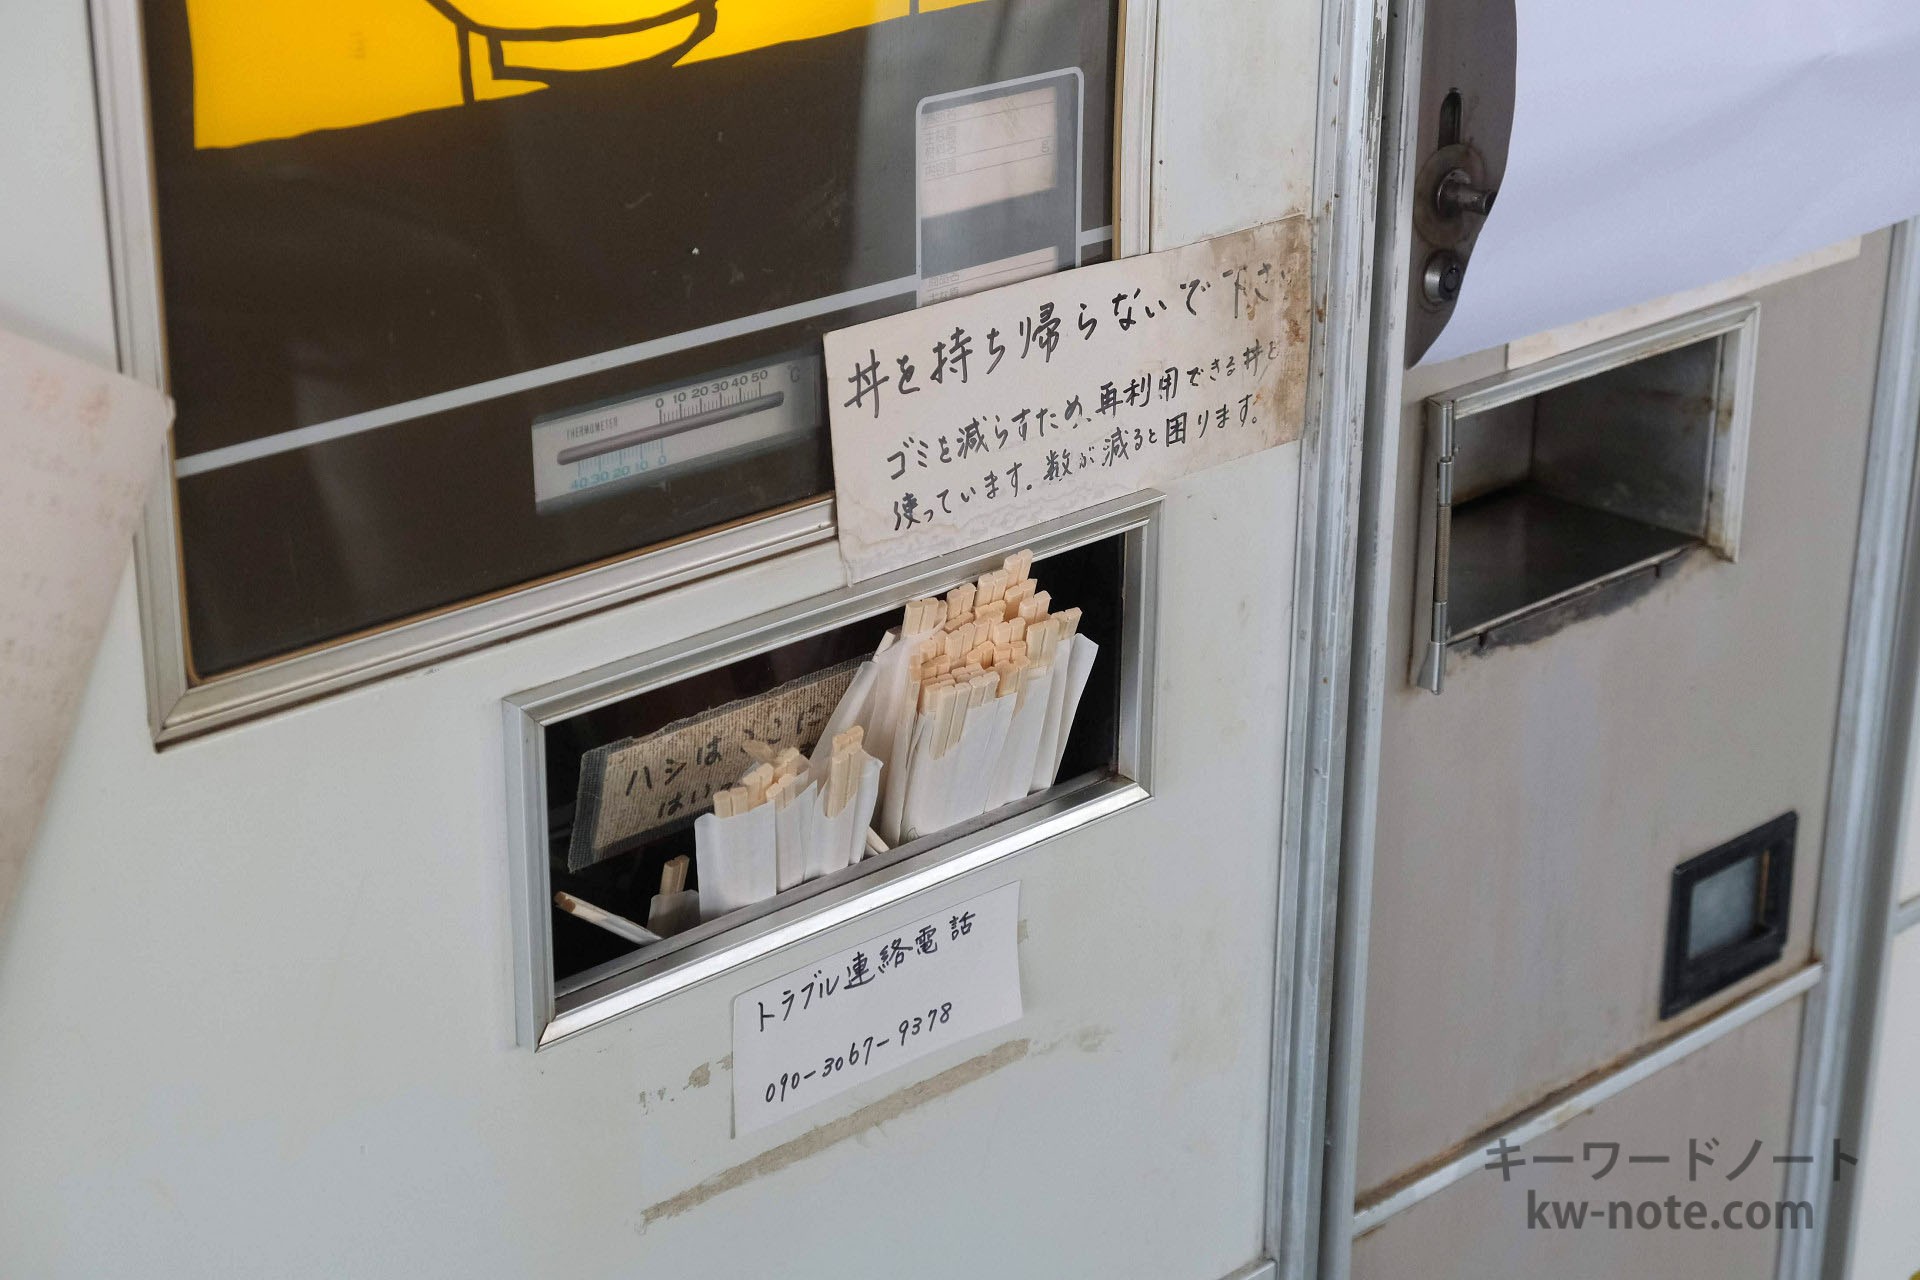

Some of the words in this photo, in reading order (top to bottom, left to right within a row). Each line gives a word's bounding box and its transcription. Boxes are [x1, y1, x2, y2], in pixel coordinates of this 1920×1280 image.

[655, 397, 664, 409] 0
[673, 391, 687, 404] 10
[692, 385, 709, 399] 20
[711, 380, 729, 394] 30
[731, 374, 749, 389] 40
[751, 369, 768, 383] 50
[566, 416, 619, 441] THERMOMETER
[570, 476, 588, 490] 40
[590, 470, 610, 484] 30
[610, 465, 630, 480] 20
[636, 459, 649, 473] 10
[658, 454, 667, 466] 0
[758, 911, 976, 1032] トラブル連絡電話
[765, 1002, 952, 1103] 090-3067-9378
